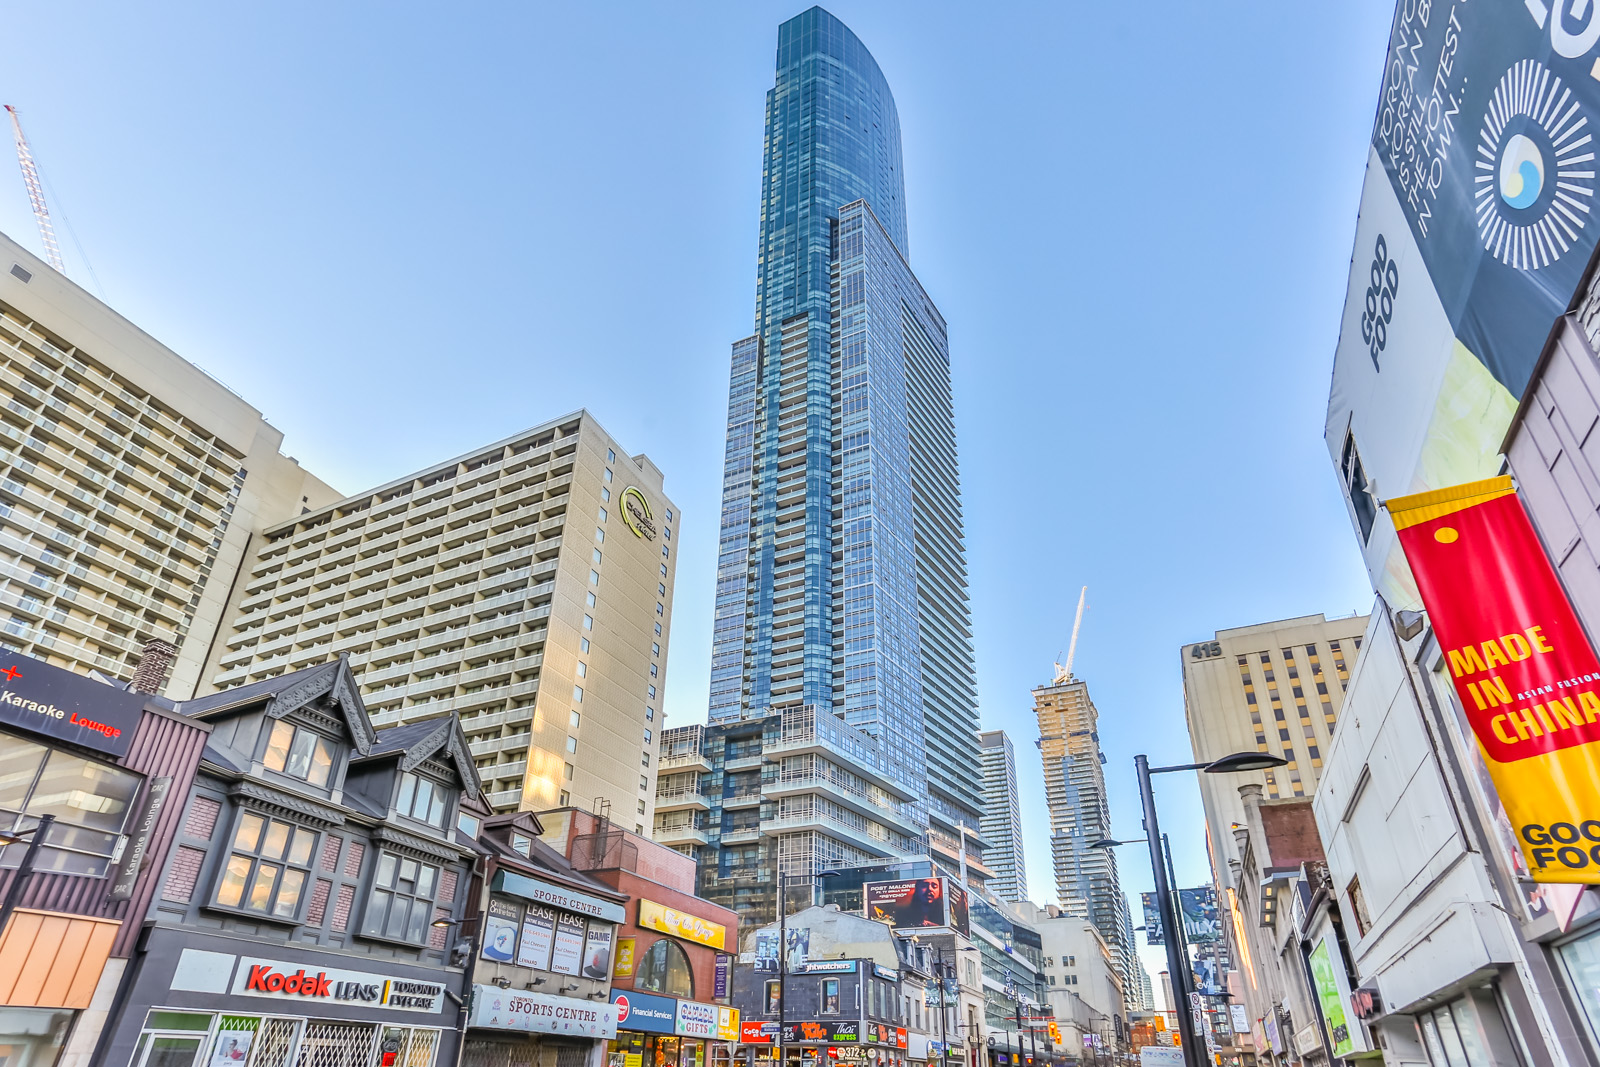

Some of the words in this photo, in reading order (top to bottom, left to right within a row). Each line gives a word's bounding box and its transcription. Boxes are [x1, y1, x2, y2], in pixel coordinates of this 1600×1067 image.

[1389, 29, 1424, 169] KOREAN
[1407, 155, 1427, 212] THE
[1422, 5, 1462, 157] HOTTEST
[1399, 162, 1410, 192] IS
[1405, 95, 1427, 163] STILL
[1418, 199, 1432, 238] IN
[1361, 233, 1388, 345] GOOD
[1370, 258, 1399, 373] FOOD
[1191, 642, 1223, 659] 415
[1448, 625, 1554, 678] MADE
[1467, 675, 1514, 711] IN
[1517, 684, 1554, 701] ASIAN
[1557, 671, 1600, 690] FUSION
[1, 690, 65, 720] Karaoke
[69, 712, 122, 738] Lounge
[1490, 690, 1600, 744] CHINA
[125, 836, 146, 877] Karaoke
[140, 798, 160, 832] Lounge
[526, 903, 554, 921] LEASE
[533, 889, 568, 906] SPORTS
[569, 899, 603, 916] CENTRE
[559, 911, 585, 928] LEASE
[588, 930, 611, 942] GAME
[249, 965, 334, 997] Kodak
[335, 981, 379, 1001] LENS
[392, 981, 441, 996] TORONTO
[509, 1001, 553, 1017] SPORTS
[555, 1007, 597, 1022] CENTRE
[653, 1009, 672, 1020] Services
[686, 1022, 708, 1033] GIFTS
[833, 1033, 857, 1041] express
[845, 1047, 860, 1057] 372
